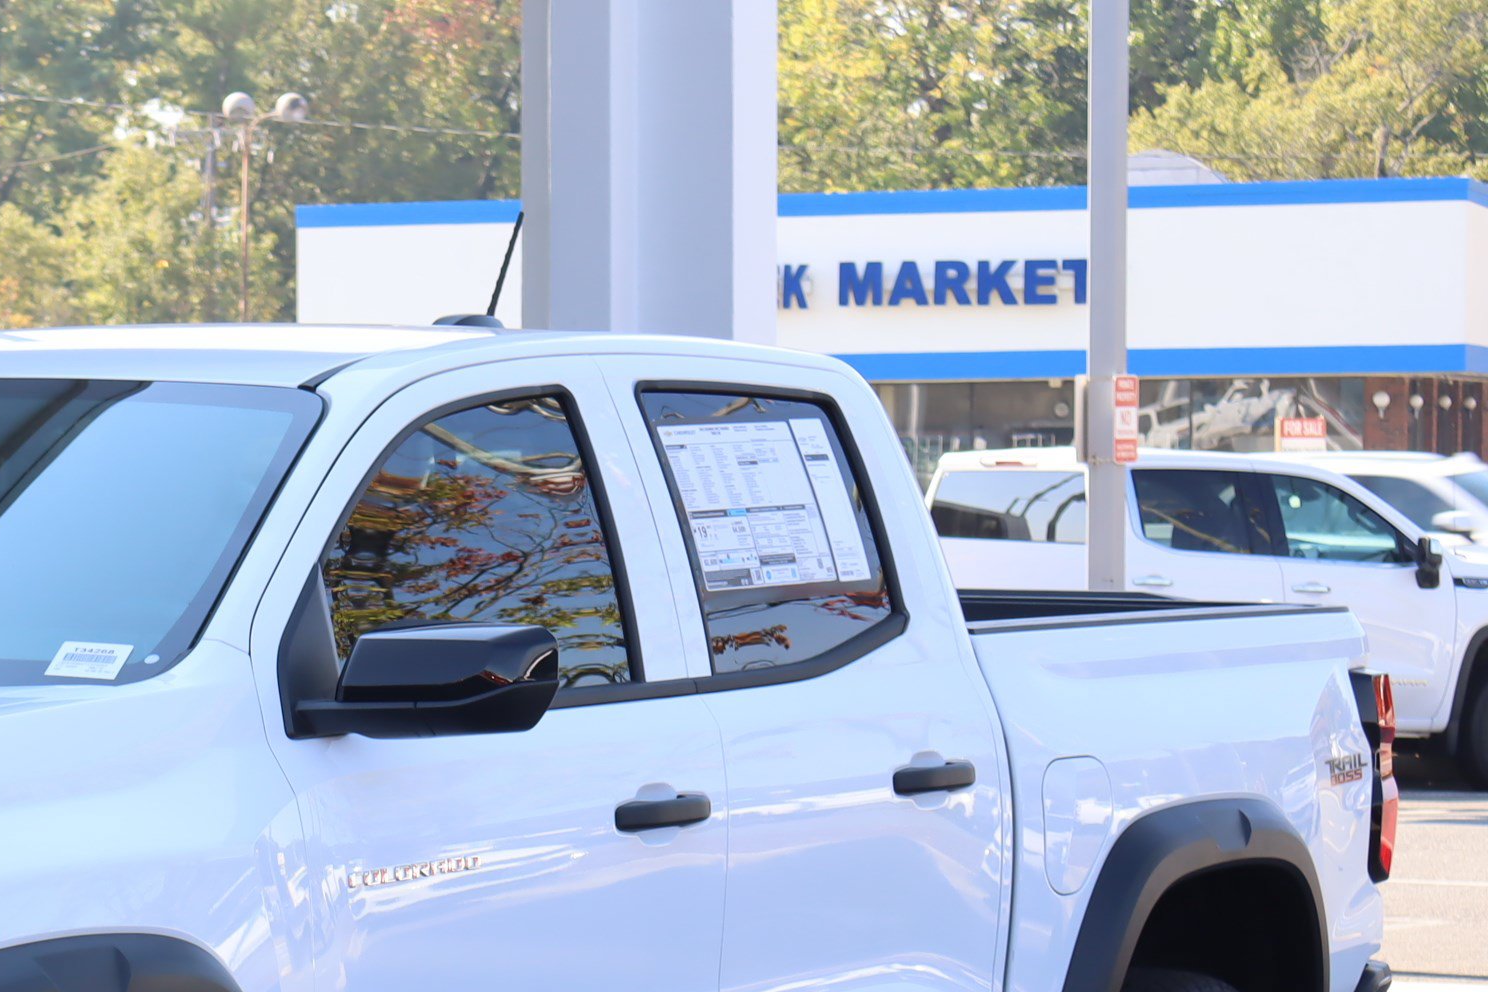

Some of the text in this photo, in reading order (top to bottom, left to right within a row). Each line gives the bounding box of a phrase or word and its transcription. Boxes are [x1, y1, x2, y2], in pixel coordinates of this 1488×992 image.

[777, 258, 1088, 309] K MARKET
[1283, 421, 1324, 436] FOR SALE
[1325, 754, 1368, 773] TRAIL
[348, 857, 480, 888] COLORADO
